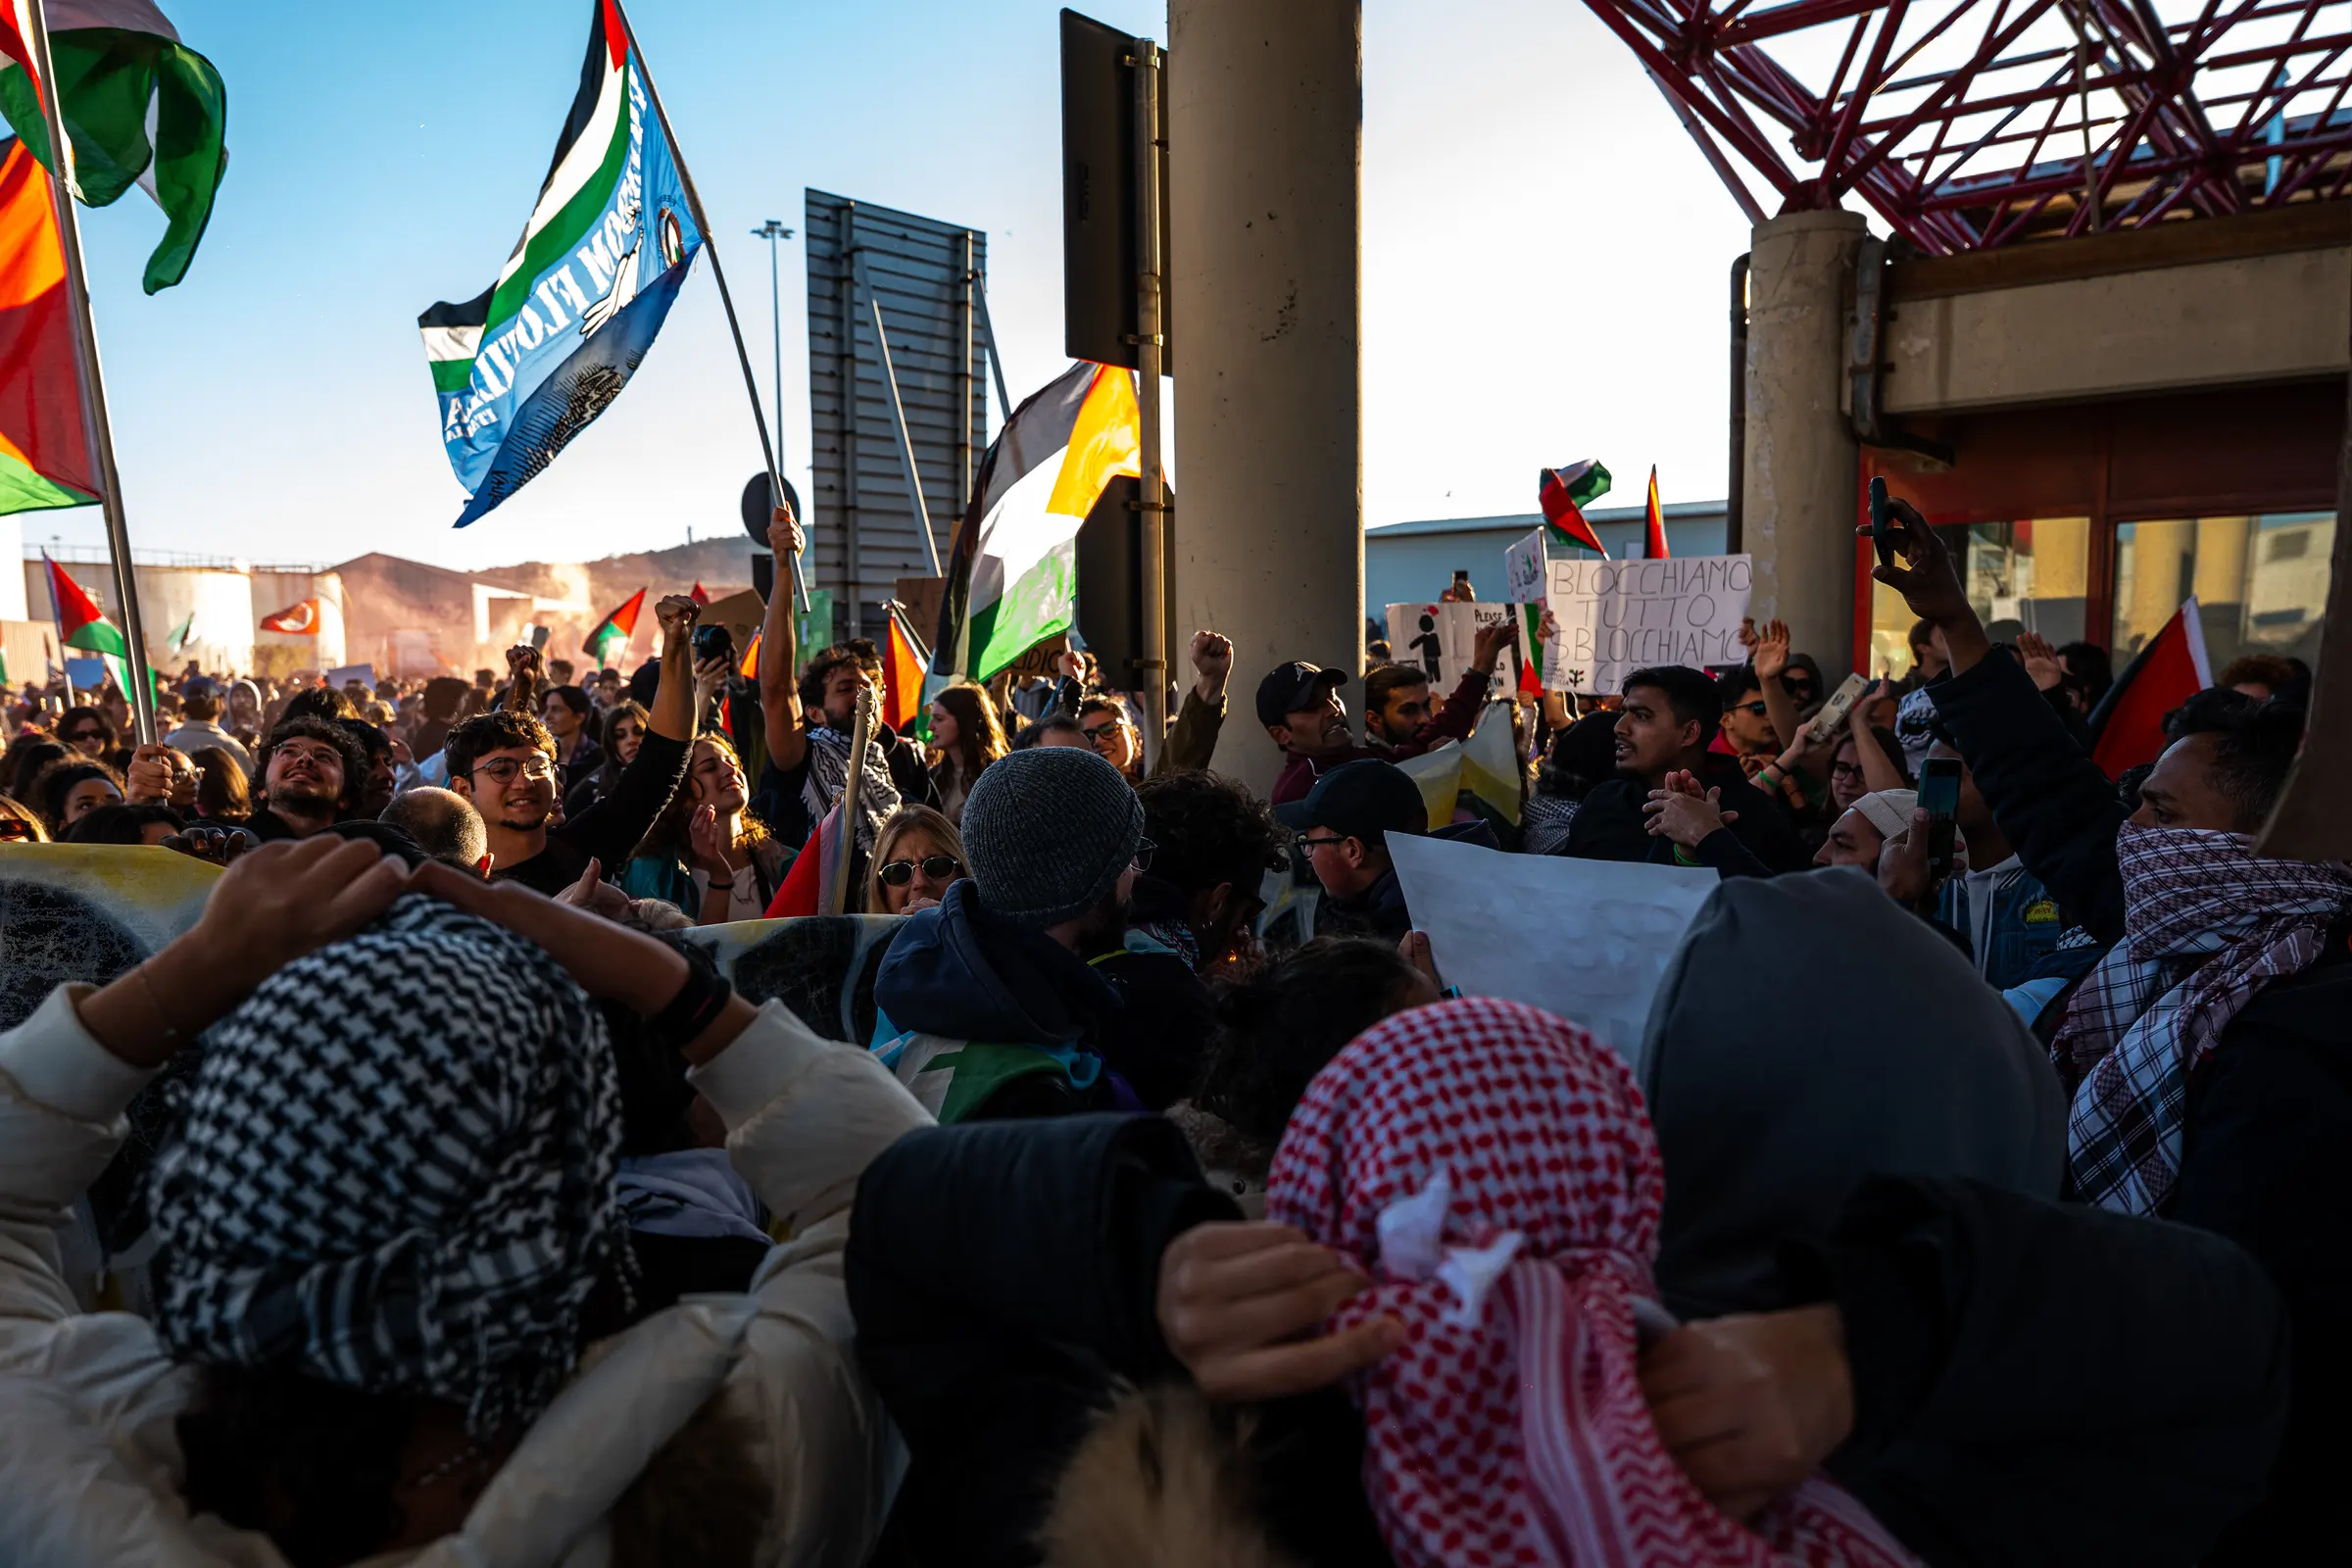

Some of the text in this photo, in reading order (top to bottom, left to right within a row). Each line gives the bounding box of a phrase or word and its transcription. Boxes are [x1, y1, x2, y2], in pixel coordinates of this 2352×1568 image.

[1553, 560, 1752, 595] BLOCCHIAMO
[1474, 609, 1502, 623] PLEASE
[1576, 594, 1715, 628] TUTTO
[1550, 627, 1748, 662] SBLOCCHIAMO
